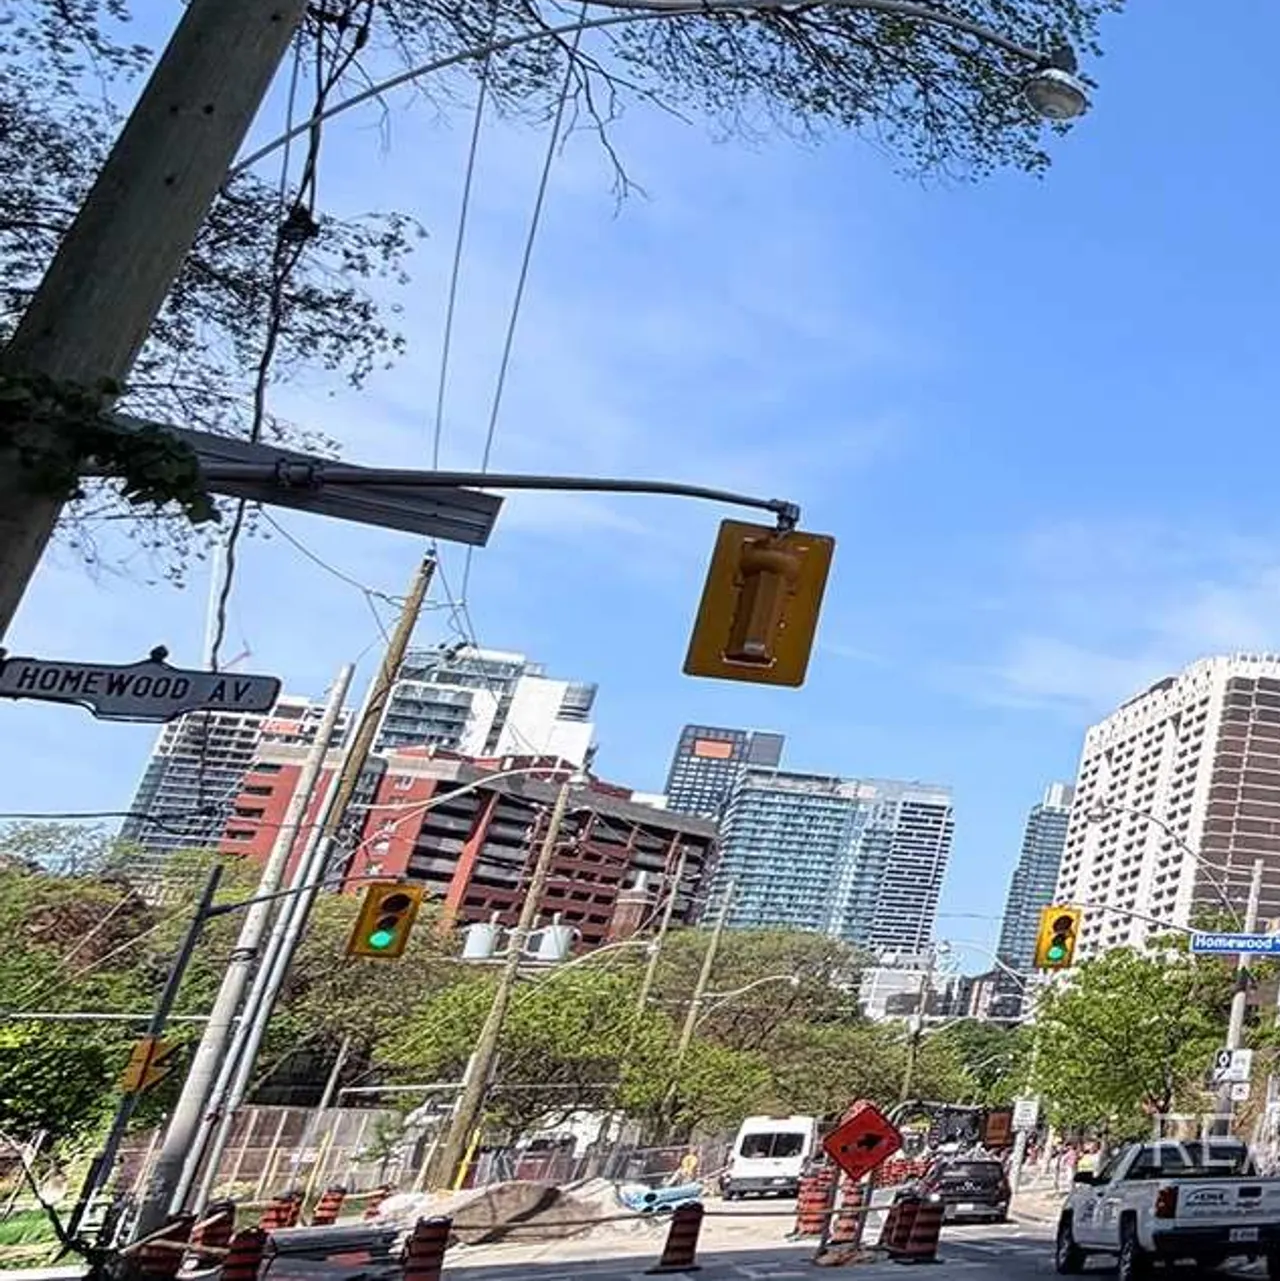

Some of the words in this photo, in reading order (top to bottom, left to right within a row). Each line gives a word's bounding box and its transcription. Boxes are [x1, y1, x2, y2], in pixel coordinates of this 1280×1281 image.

[17, 666, 190, 700] HOMEWOOD
[208, 680, 255, 704] AV.
[1195, 934, 1273, 949] Homewood
